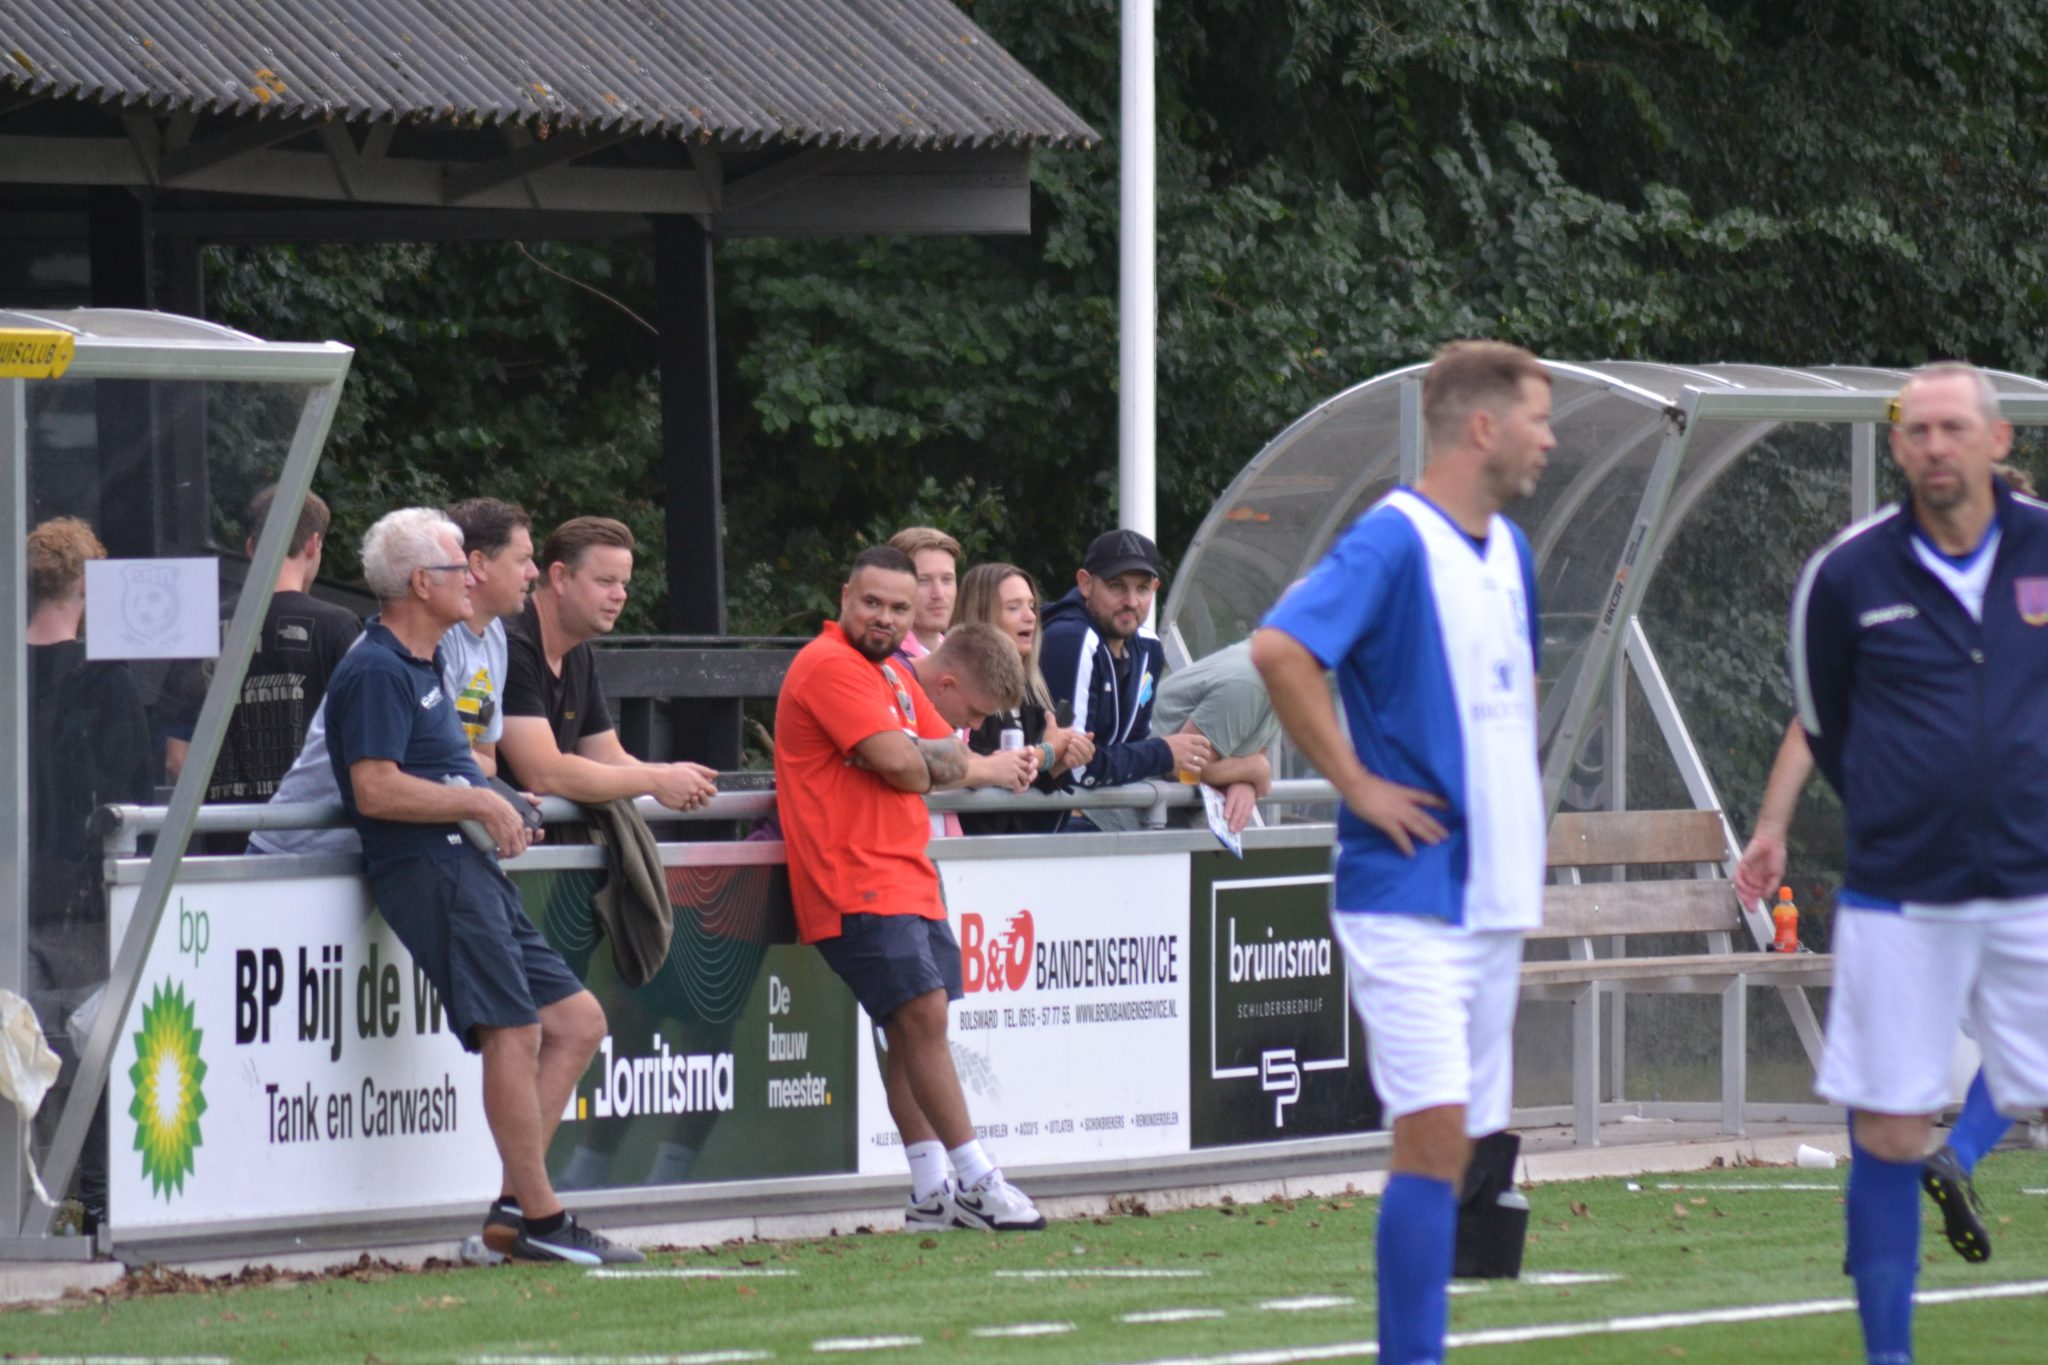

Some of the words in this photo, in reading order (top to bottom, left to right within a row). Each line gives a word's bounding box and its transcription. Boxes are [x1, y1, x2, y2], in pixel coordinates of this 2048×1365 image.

[179, 896, 210, 969] bp
[1036, 935, 1178, 990] BANDENSERVICE
[1229, 917, 1331, 982] bruinsma
[235, 948, 284, 1045] BP
[298, 945, 343, 1063] bij
[356, 943, 400, 1040] de
[769, 975, 791, 1015] De
[960, 1009, 998, 1031] BOLSWARD
[1003, 1007, 1018, 1028] TEL.
[1019, 1007, 1036, 1027] 0515
[1052, 1005, 1061, 1025] 77
[1238, 997, 1323, 1018] SCHILDERSBEDRIJF
[595, 1033, 734, 1118] Jorritsma
[769, 1071, 832, 1108] meester.
[265, 1082, 319, 1145] Tank
[326, 1091, 352, 1140] en
[360, 1073, 457, 1138] Carwash
